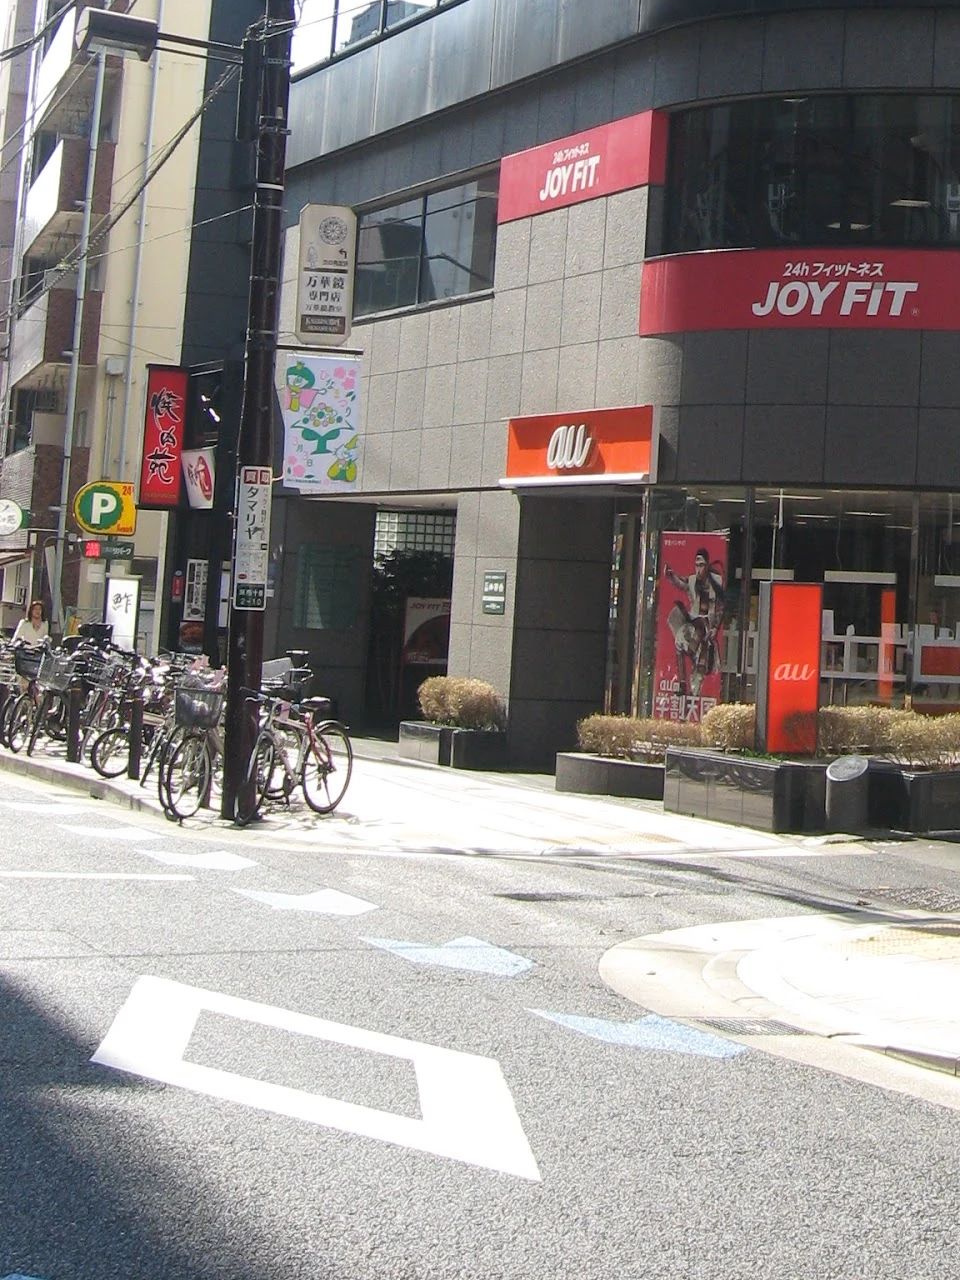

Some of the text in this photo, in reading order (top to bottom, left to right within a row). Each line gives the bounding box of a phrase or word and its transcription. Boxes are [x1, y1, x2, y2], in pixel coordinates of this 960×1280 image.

[539, 163, 574, 201] JOY
[306, 276, 345, 289] 万華鏡
[782, 262, 884, 277] 24h フィットネス
[751, 281, 840, 316] JOY
[547, 424, 592, 469] au
[91, 492, 117, 524] P
[774, 662, 816, 682] au
